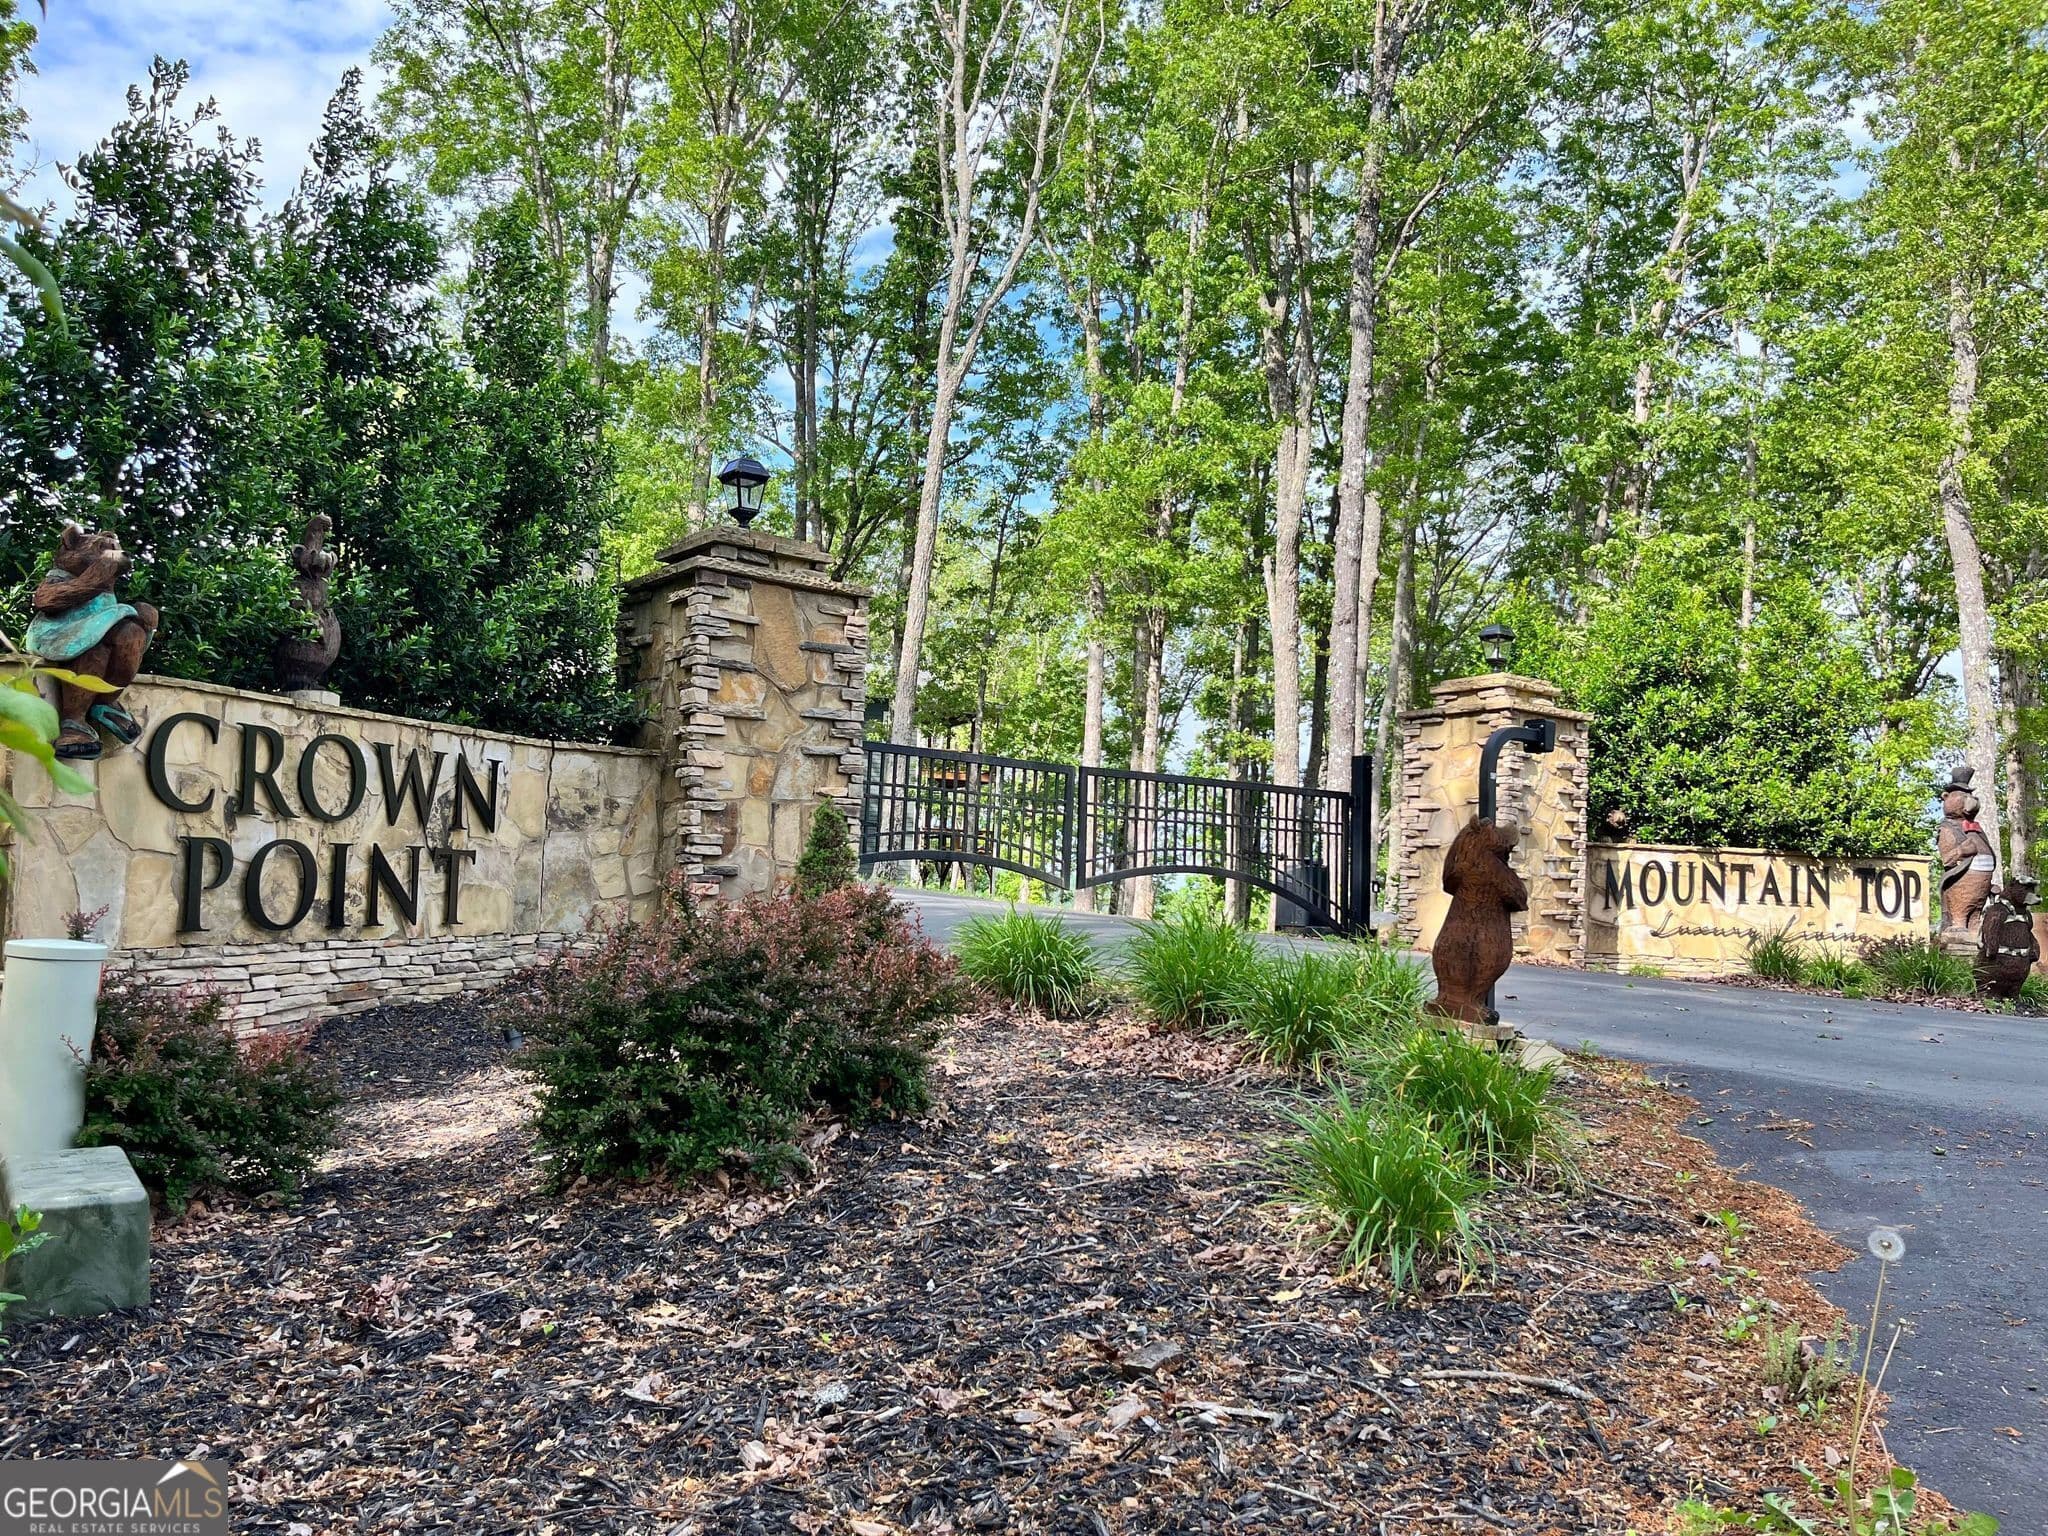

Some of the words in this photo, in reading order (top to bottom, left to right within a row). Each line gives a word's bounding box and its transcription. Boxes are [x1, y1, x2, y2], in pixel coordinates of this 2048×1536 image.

[147, 712, 501, 834] CROWN
[177, 836, 476, 933] POINT
[1604, 858, 1831, 910] MOUNTAIN
[1853, 867, 1922, 923] TOP
[1650, 910, 1761, 949] Luxury
